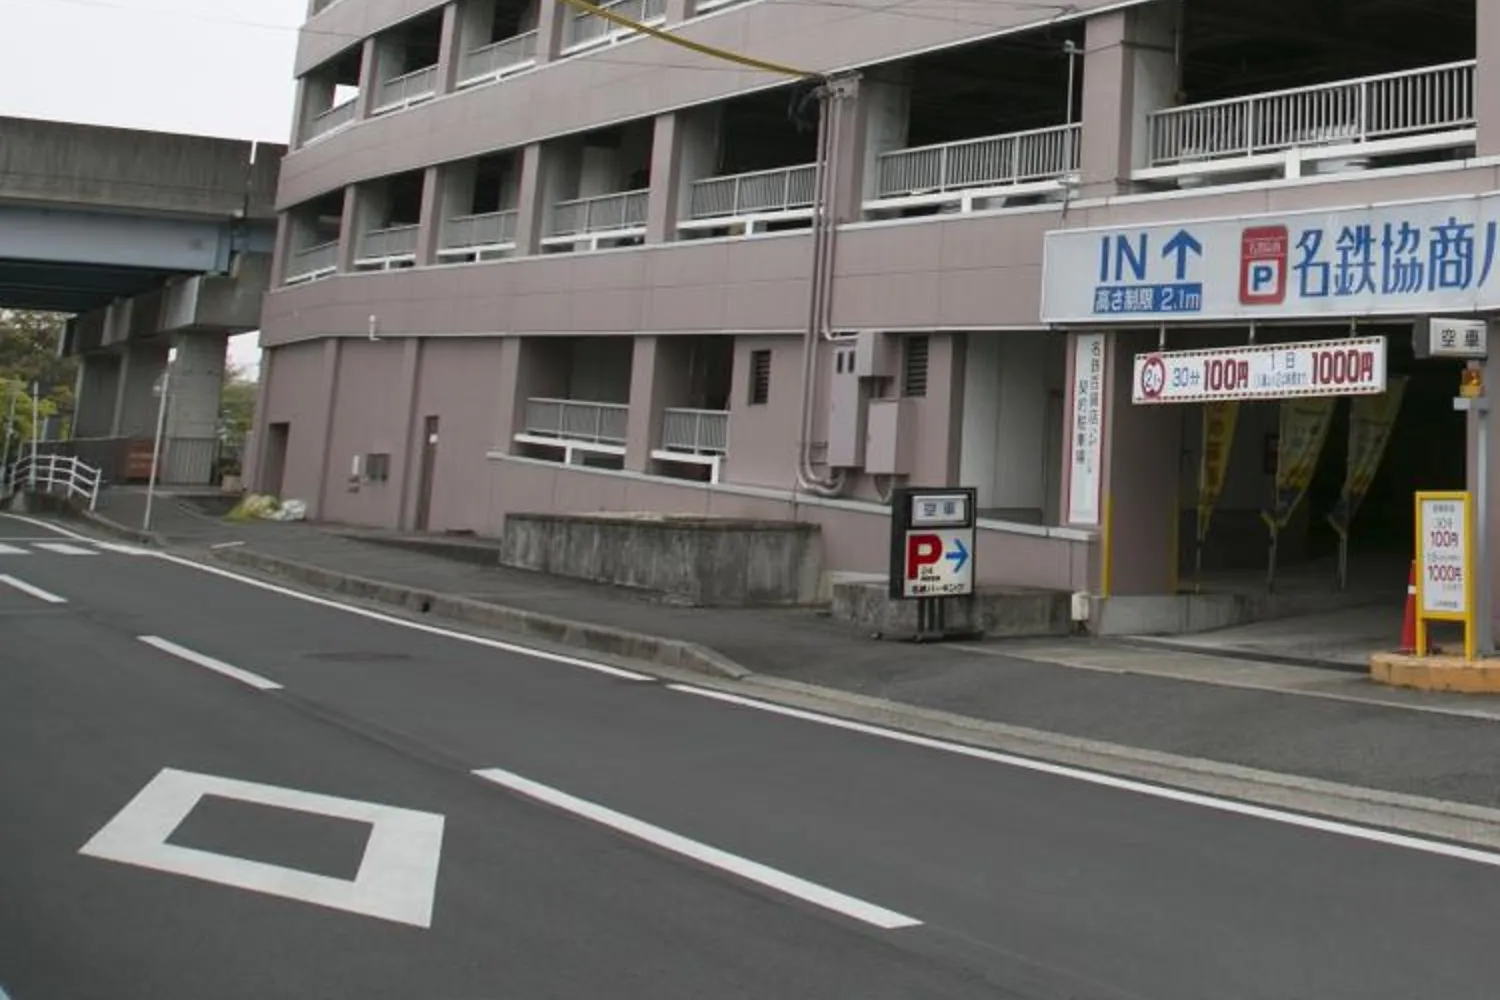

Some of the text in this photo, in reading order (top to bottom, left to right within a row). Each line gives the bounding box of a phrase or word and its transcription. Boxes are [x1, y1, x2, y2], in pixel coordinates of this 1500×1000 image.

[1101, 232, 1148, 282] IN
[1252, 265, 1273, 291] P
[1160, 287, 1200, 311] 2.1m
[1440, 328, 1480, 348] 空車
[1173, 367, 1200, 388] 30分
[1204, 359, 1249, 391] 100円
[1312, 350, 1374, 385] 1000円
[908, 534, 943, 580] P
